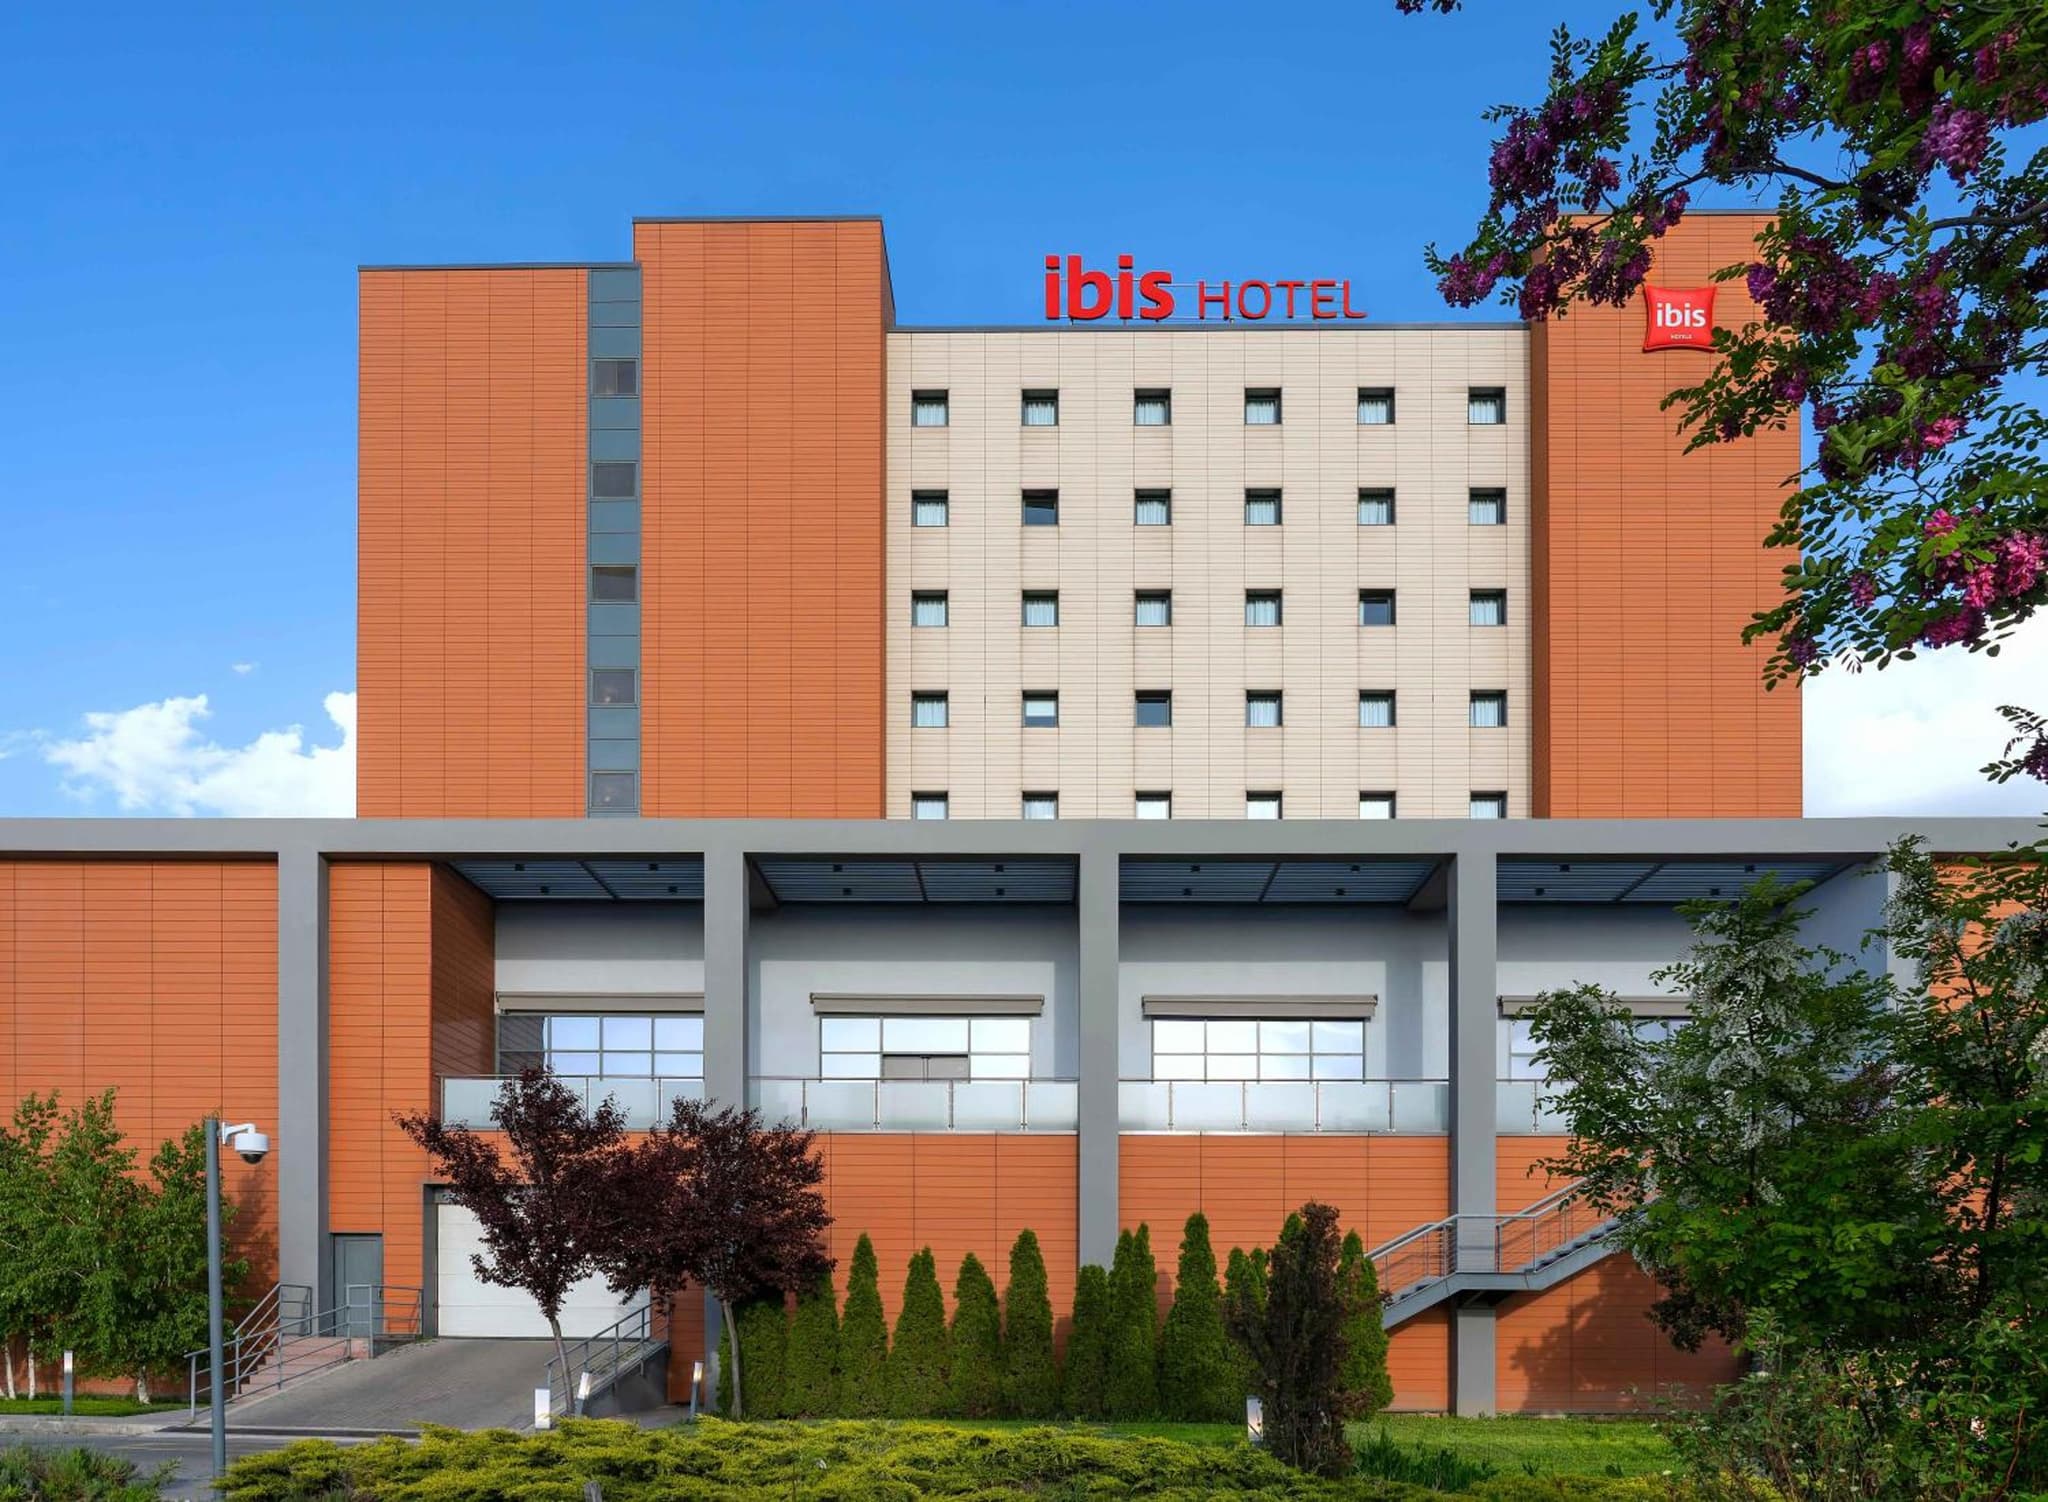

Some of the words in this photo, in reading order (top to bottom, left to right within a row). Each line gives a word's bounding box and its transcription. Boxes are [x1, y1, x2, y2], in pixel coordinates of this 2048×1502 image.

[1045, 255, 1176, 320] ibis
[1199, 280, 1368, 319] HOTEL
[1656, 302, 1706, 327] ibis
